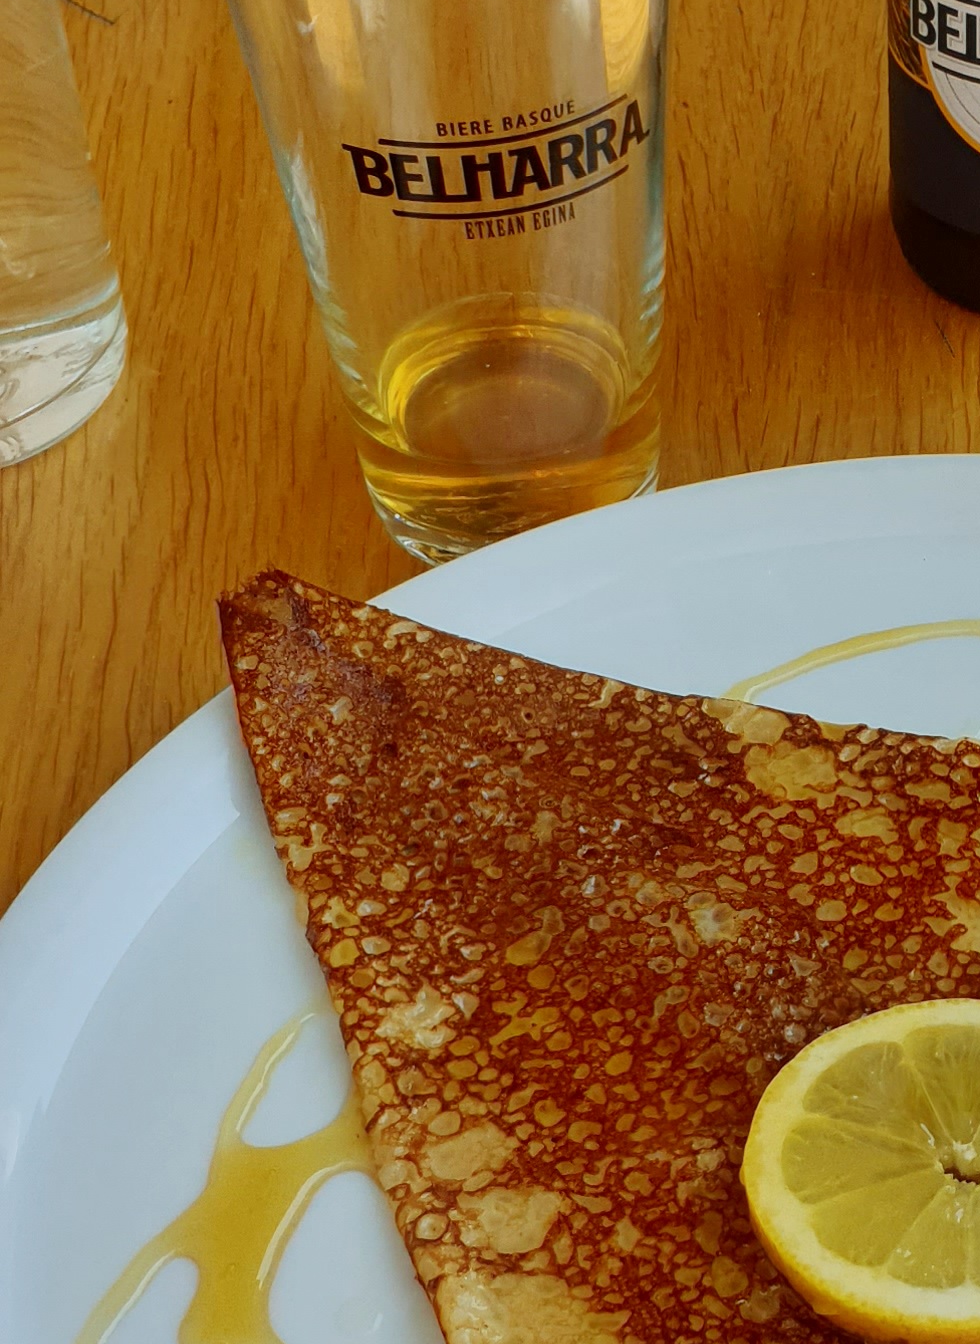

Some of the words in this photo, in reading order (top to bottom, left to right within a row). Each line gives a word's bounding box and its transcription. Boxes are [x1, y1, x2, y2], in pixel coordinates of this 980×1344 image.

[436, 119, 494, 137] BIERE
[502, 100, 575, 131] BASQUE
[341, 99, 650, 203] BELHARRA
[464, 215, 526, 240] ETXEAN
[532, 202, 576, 231] EGINA
